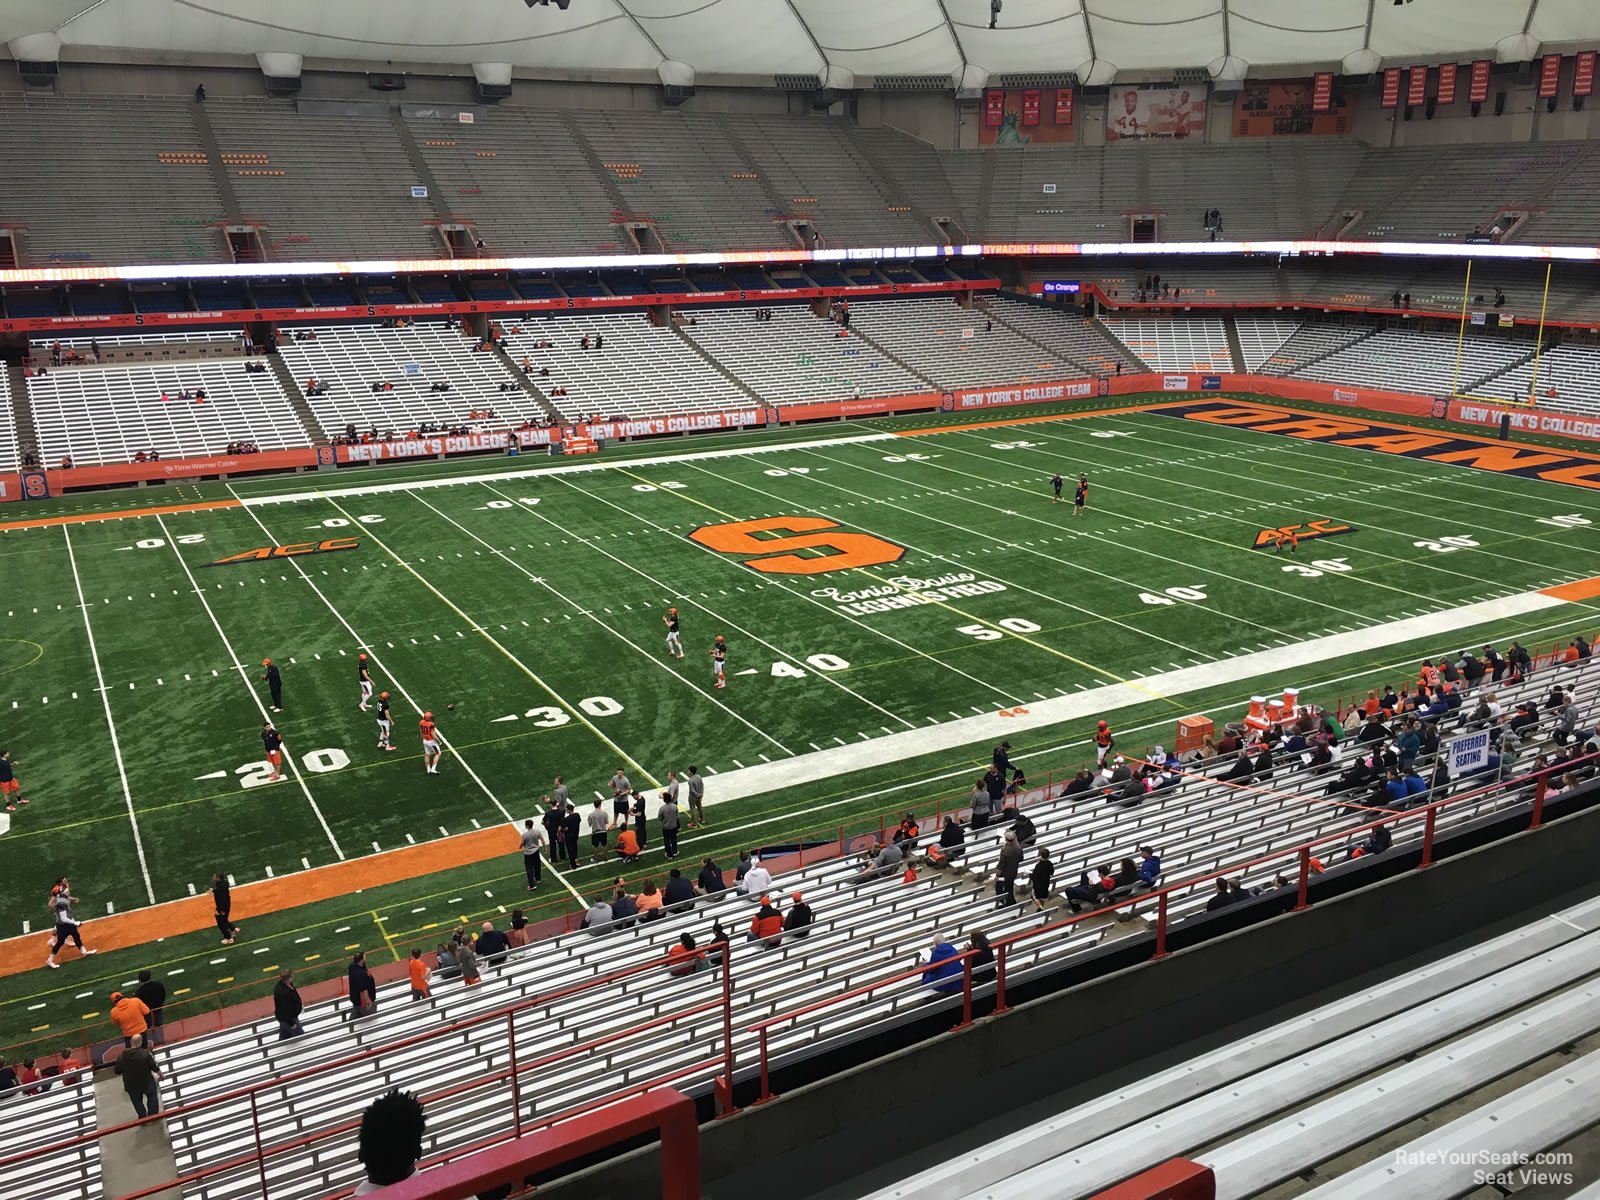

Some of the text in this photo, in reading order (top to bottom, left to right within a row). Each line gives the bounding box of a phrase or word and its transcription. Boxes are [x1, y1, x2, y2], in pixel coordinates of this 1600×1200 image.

[1153, 83, 1180, 91] BROWN
[983, 244, 1032, 255] SYRACUSE
[1034, 243, 1080, 254] FOOTBALL
[1044, 283, 1055, 291] Go
[1056, 283, 1080, 292] Orange
[3, 322, 14, 331] 114
[961, 383, 1091, 407] NEW YORK'S COLLEGE TEAM
[1432, 399, 1447, 418] S
[617, 419, 665, 436] YORK'S
[667, 414, 722, 433] COLLEGE
[724, 410, 757, 427] TEAM
[1460, 405, 1489, 422] NEW
[1540, 417, 1600, 437] COLLEGE
[320, 447, 335, 465] S
[347, 444, 383, 462] NEW
[384, 438, 442, 458] YORK'S
[444, 432, 509, 453] COLLEGE
[174, 460, 237, 472] Time Warner Cable
[25, 474, 46, 497] S
[1534, 513, 1593, 528] 10
[1253, 517, 1358, 550] ACC
[1412, 536, 1481, 553] 20
[204, 535, 365, 567] ACC
[686, 515, 910, 576] S
[1281, 558, 1354, 578] 30
[810, 572, 976, 602] Ernie Davis
[836, 580, 1008, 617] LEGENDS FIELD
[1137, 585, 1208, 606] 40
[955, 617, 1042, 641] 50
[770, 652, 851, 679] 40
[524, 695, 625, 728] 30
[1452, 733, 1487, 755] PREFERRED
[234, 747, 351, 789] 20
[1455, 749, 1482, 768] SEATING
